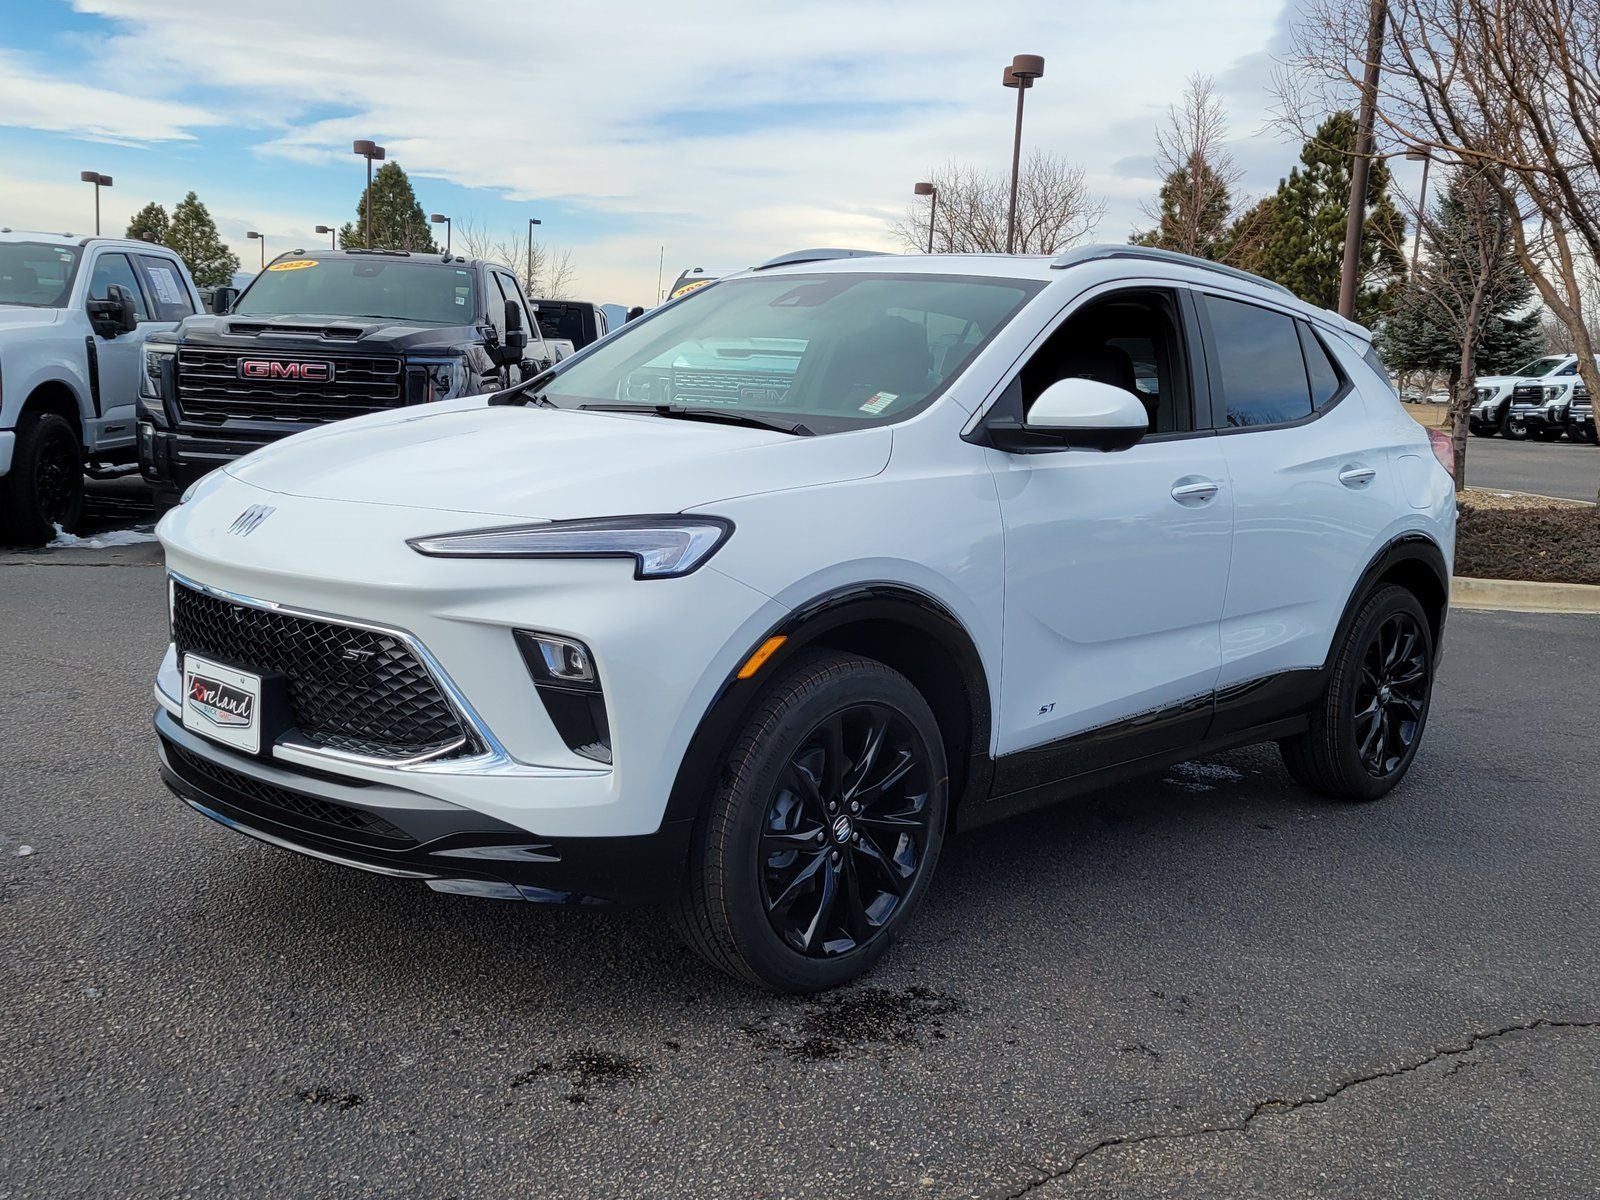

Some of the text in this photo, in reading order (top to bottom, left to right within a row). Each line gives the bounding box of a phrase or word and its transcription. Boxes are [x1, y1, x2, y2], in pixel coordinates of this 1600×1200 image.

[243, 361, 327, 379] GMC
[342, 649, 375, 662] ST
[1037, 702, 1057, 716] ST
